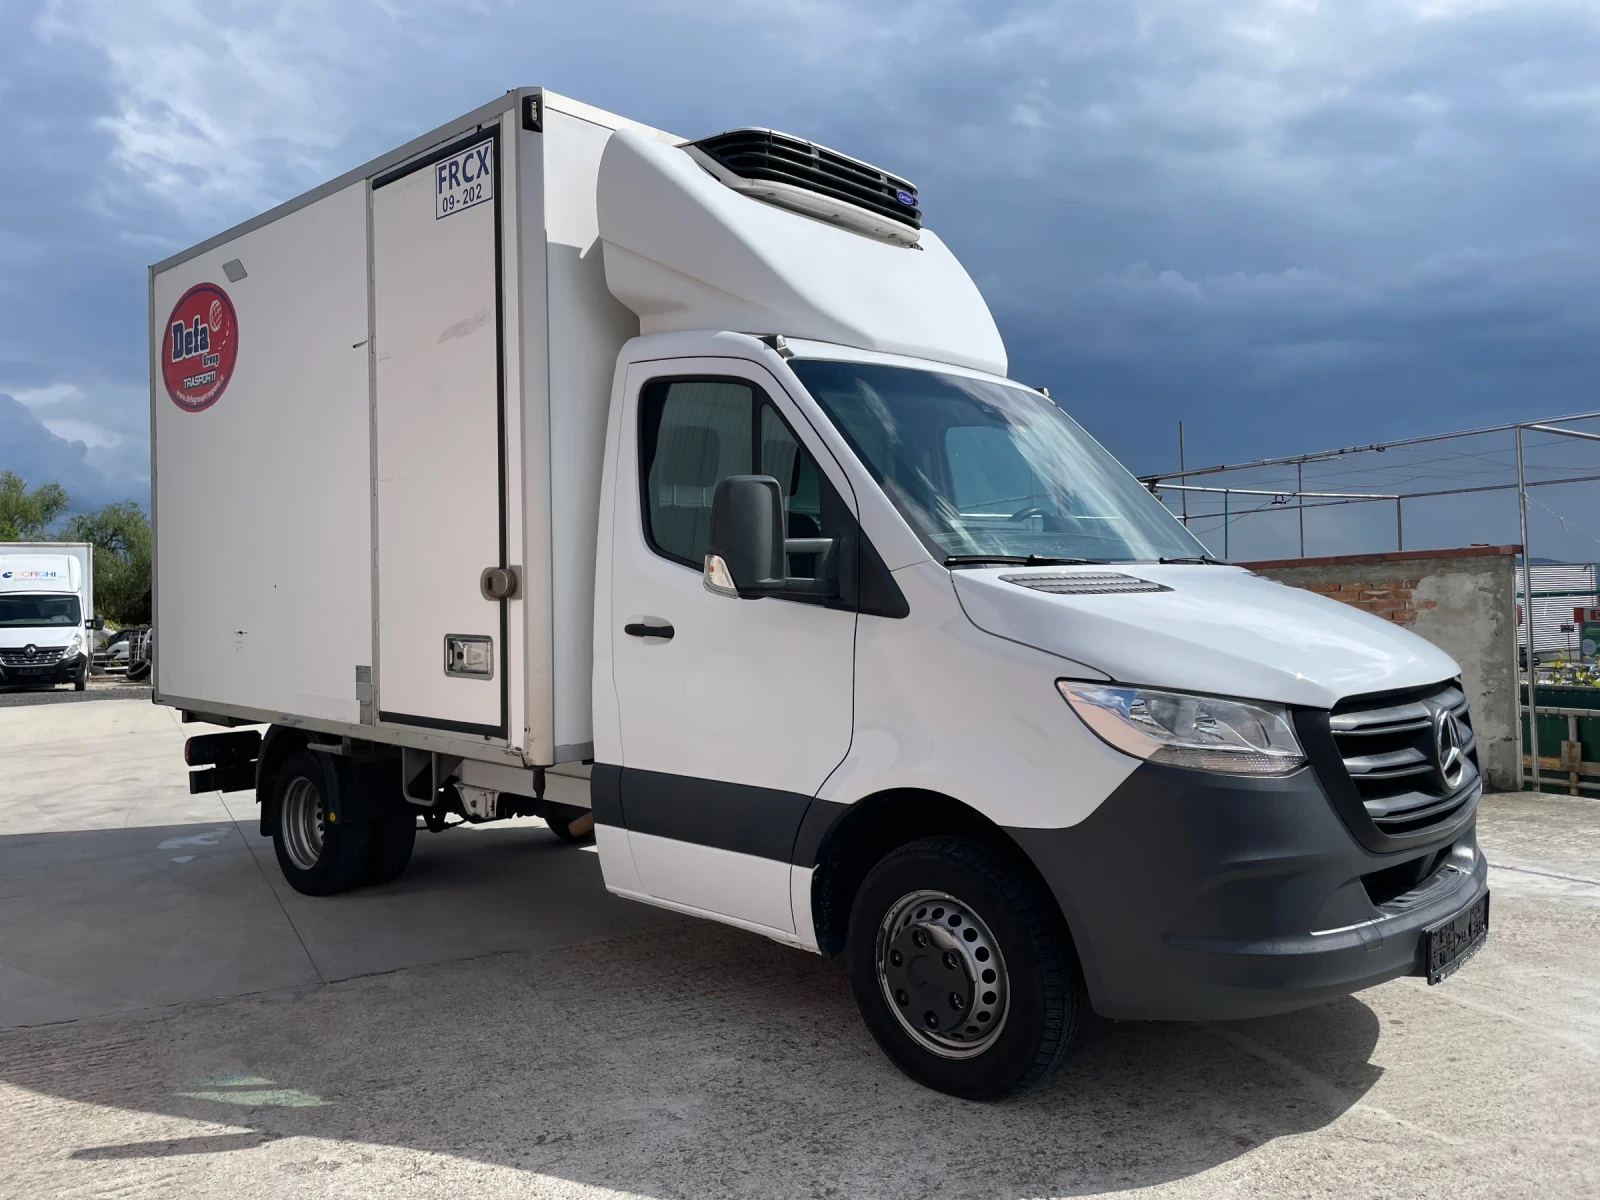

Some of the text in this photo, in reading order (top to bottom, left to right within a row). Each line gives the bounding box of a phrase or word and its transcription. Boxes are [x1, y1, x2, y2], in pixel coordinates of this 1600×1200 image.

[438, 145, 490, 195] FRCX
[172, 315, 210, 362] Defa
[203, 353, 219, 367] Group
[183, 371, 216, 389] TRASPORTI
